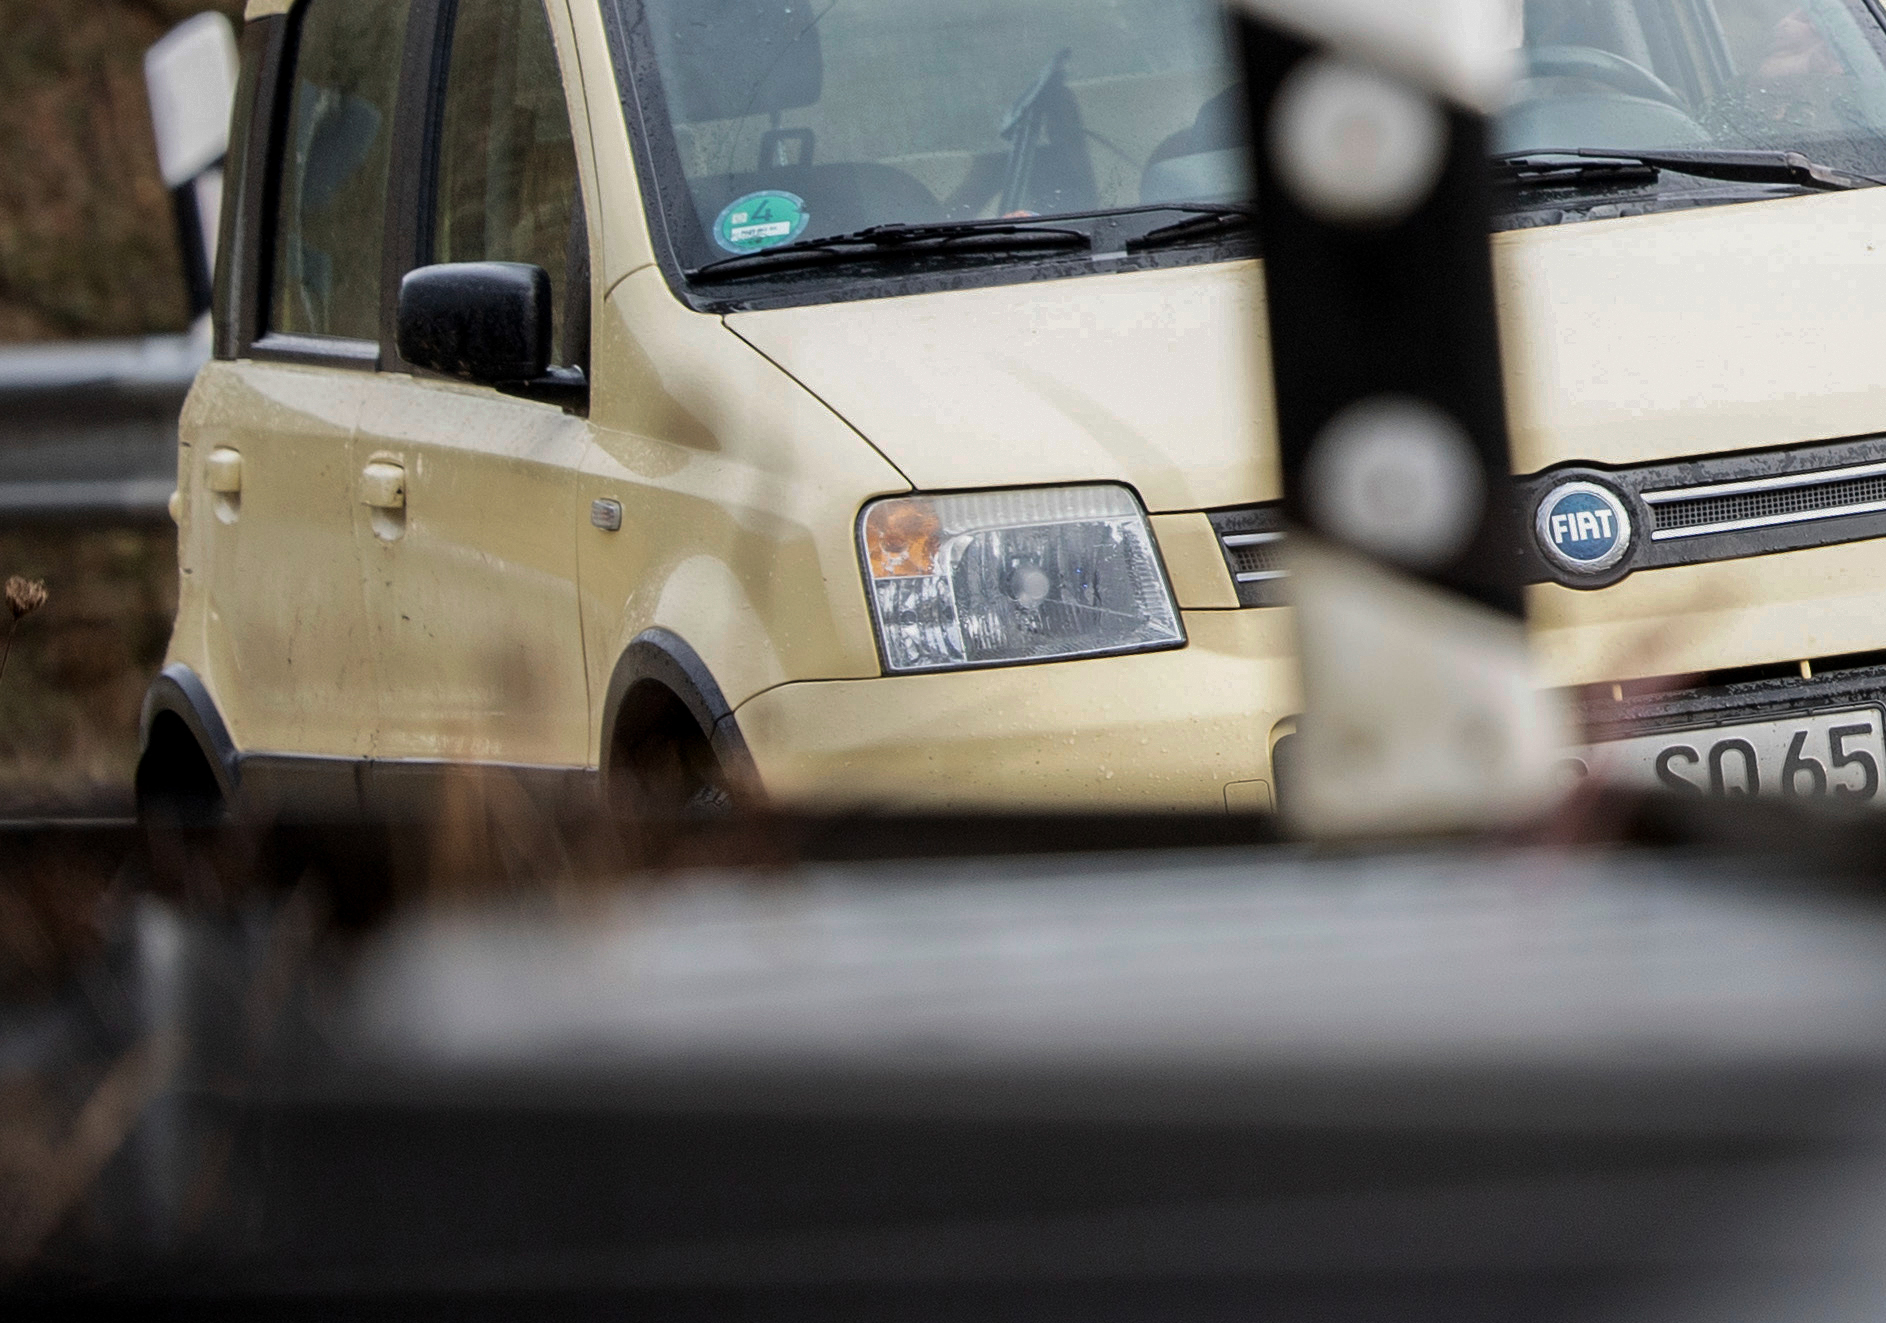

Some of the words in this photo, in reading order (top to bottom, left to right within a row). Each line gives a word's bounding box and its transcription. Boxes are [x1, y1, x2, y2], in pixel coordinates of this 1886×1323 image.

[751, 199, 773, 221] 4
[1551, 508, 1613, 544] FIAT
[1781, 722, 1880, 804] 65
